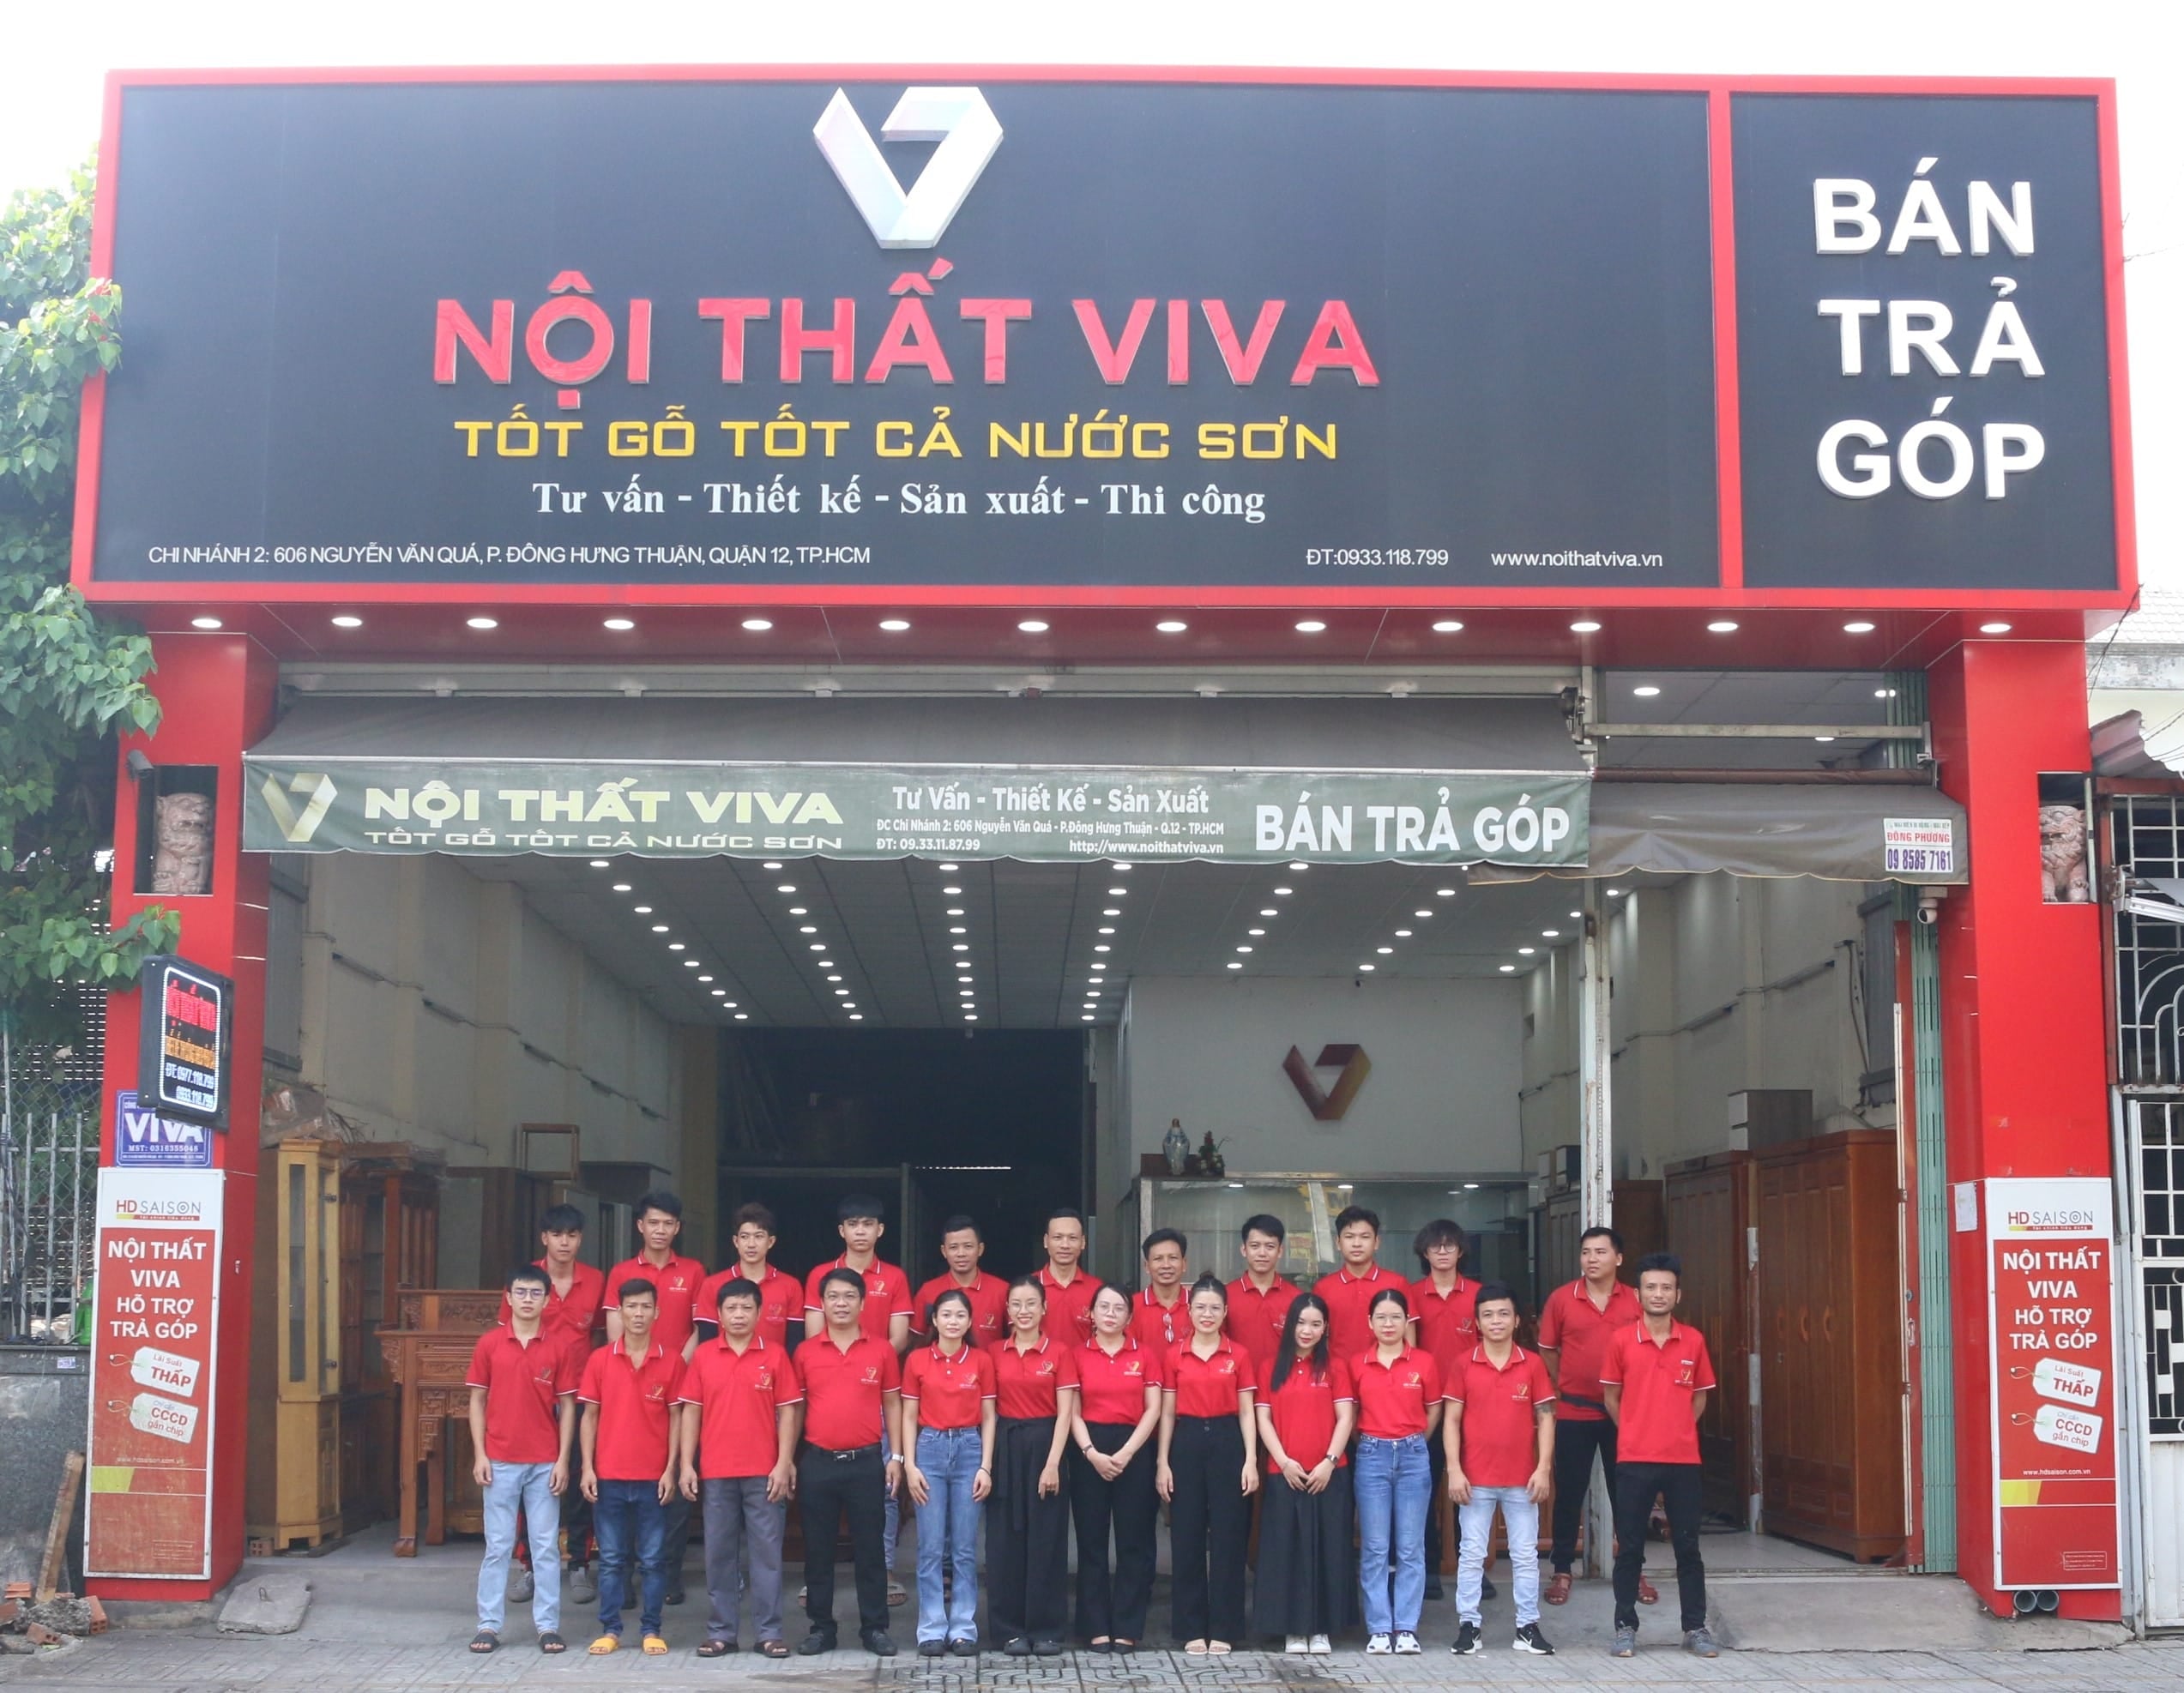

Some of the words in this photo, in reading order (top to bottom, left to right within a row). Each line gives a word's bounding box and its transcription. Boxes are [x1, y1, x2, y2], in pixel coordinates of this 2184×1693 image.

[1813, 157, 2035, 256] BÁN
[433, 269, 652, 409] NỘI
[697, 256, 1033, 385] THẤT
[1071, 298, 1380, 387] VIVA
[1817, 276, 2046, 377] TRẢ
[455, 403, 583, 458] TỐT
[607, 405, 696, 458] GỖ
[721, 403, 850, 458] TỐT
[875, 407, 963, 459] CẢ
[989, 409, 1170, 459] NƯỚC
[1198, 416, 1337, 460] SƠN
[1816, 396, 2046, 501] GÓP
[532, 482, 588, 514] Tư
[601, 473, 666, 514] vấn
[703, 473, 801, 514] Thiết
[819, 474, 862, 514] kế
[900, 482, 968, 515] Sản
[985, 475, 1065, 515] xuất
[1100, 484, 1167, 515] Thi
[1181, 484, 1266, 524] công
[148, 545, 180, 563] CHI
[183, 542, 250, 563] NHÁNH
[253, 545, 270, 563] 2:
[273, 545, 308, 564] 606
[310, 541, 393, 564] NGUYỄN
[395, 543, 434, 564] VĂN
[437, 543, 484, 567] QUÁ,
[486, 545, 503, 563] P.
[505, 542, 566, 564] ĐÔNG
[570, 545, 630, 564] HƯNG
[633, 544, 706, 569] THUẬN,
[708, 544, 767, 568] QUẬN
[769, 546, 793, 567] 12,
[795, 546, 872, 564] TP.HCM
[1305, 548, 1450, 566] ĐT:0933.118.799
[1491, 550, 1663, 567] www.noithatviva.vn
[364, 780, 480, 828] NỘI
[498, 777, 671, 824] THẤT
[685, 790, 844, 825] VIVA
[892, 786, 923, 810] Tư
[928, 781, 970, 811] Vấn
[992, 782, 1051, 812] Thiết
[1057, 782, 1090, 812] Kế
[1107, 785, 1149, 813] Sản
[1155, 784, 1210, 814] Xuất
[876, 819, 891, 832] ĐC
[893, 818, 908, 832] Chi
[910, 817, 941, 832] Nhánh
[942, 820, 952, 832] 2:
[953, 820, 973, 833] 606
[974, 816, 1011, 835] Nguyễn
[1013, 819, 1031, 833] Văn
[1033, 820, 1052, 834] Quá
[1060, 819, 1094, 836] P.Đông
[1095, 821, 1121, 836] Hưng
[1123, 821, 1152, 837] Thuận
[1161, 822, 1180, 834] Q.12
[1188, 822, 1224, 835] TP.HCM
[1255, 791, 1353, 852] BÁN
[1367, 786, 1461, 852] TRẢ
[1473, 792, 1570, 853] GÓP
[444, 827, 496, 846] GỖ
[587, 828, 639, 848] CẢ
[647, 829, 753, 849] NƯỚC
[763, 833, 842, 850] SƠN
[876, 838, 897, 850] ĐT:
[899, 838, 980, 852] 09.33.11.87.99
[1069, 840, 1224, 854] http://www.noithatviva.vn
[1887, 848, 1899, 870] 09
[1903, 849, 1926, 871] 8585
[1929, 850, 1952, 871] 7161
[124, 1112, 204, 1142] VIVA
[128, 1144, 148, 1153] MST:
[140, 1201, 202, 1214] SAISON
[2032, 1210, 2094, 1225] SAISON
[108, 1238, 146, 1262] NỘI
[150, 1237, 207, 1260] THẤT
[2003, 1249, 2041, 1274] NỘI
[2045, 1246, 2102, 1270] THẤT
[130, 1269, 181, 1287] VIVA
[2027, 1280, 2078, 1298] VIVA
[117, 1294, 146, 1314] HỖ
[150, 1298, 194, 1318] TRỢ
[2015, 1305, 2044, 1325] HỖ
[2048, 1308, 2092, 1328] TRỢ
[110, 1318, 150, 1338] TRẢ
[154, 1318, 198, 1340] GÓP
[2009, 1330, 2049, 1350] TRẢ
[2054, 1328, 2097, 1350] GÓP
[151, 1365, 192, 1387] THẤP
[2053, 1377, 2094, 1397] THẤP
[151, 1407, 188, 1426] CCCD
[2055, 1418, 2092, 1437] CCCD
[166, 1425, 184, 1437] chip
[2071, 1437, 2090, 1448] chip
